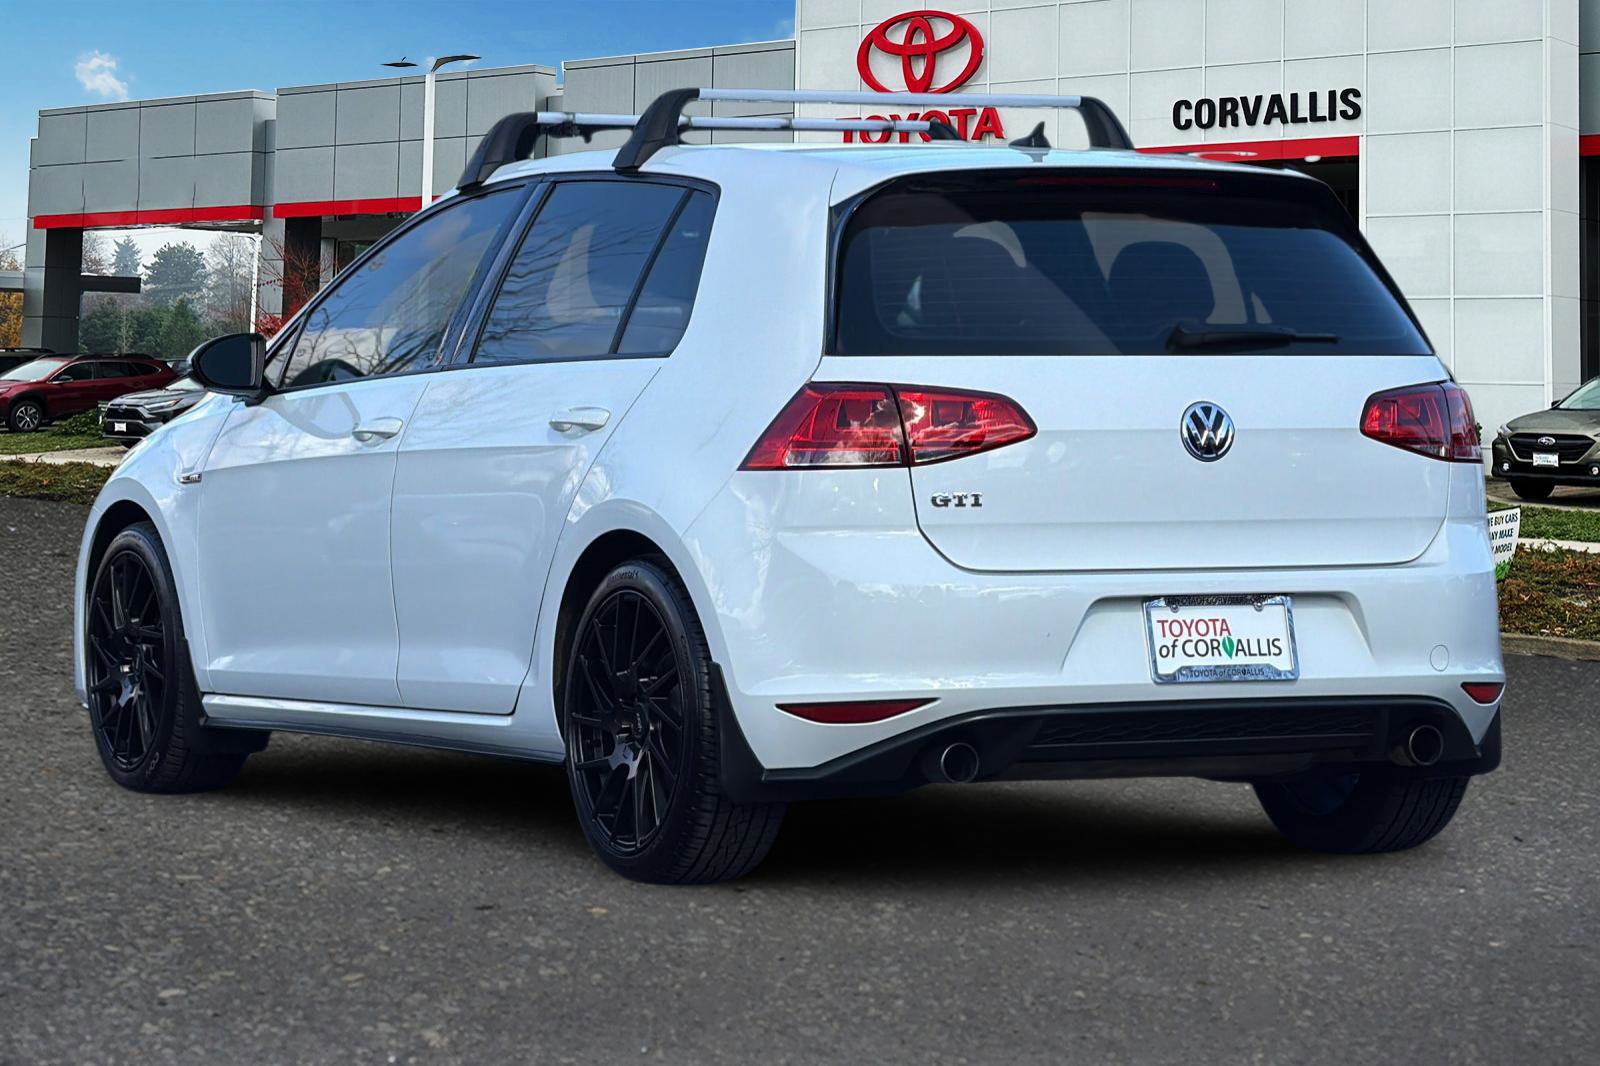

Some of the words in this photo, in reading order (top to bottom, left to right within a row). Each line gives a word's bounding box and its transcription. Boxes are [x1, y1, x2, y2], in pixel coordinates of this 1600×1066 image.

[1172, 87, 1362, 131] CORVALLIS
[930, 491, 983, 508] GTI
[1494, 515, 1504, 526] BUY
[1505, 512, 1518, 524] CARS
[1488, 530, 1498, 541] NY
[1498, 528, 1514, 539] MAKE
[1494, 542, 1512, 554] MODEL
[1156, 618, 1232, 638] TOYOTA
[1158, 638, 1179, 659] of
[1190, 669, 1218, 677] TOYOTA
[1219, 669, 1227, 677] of
